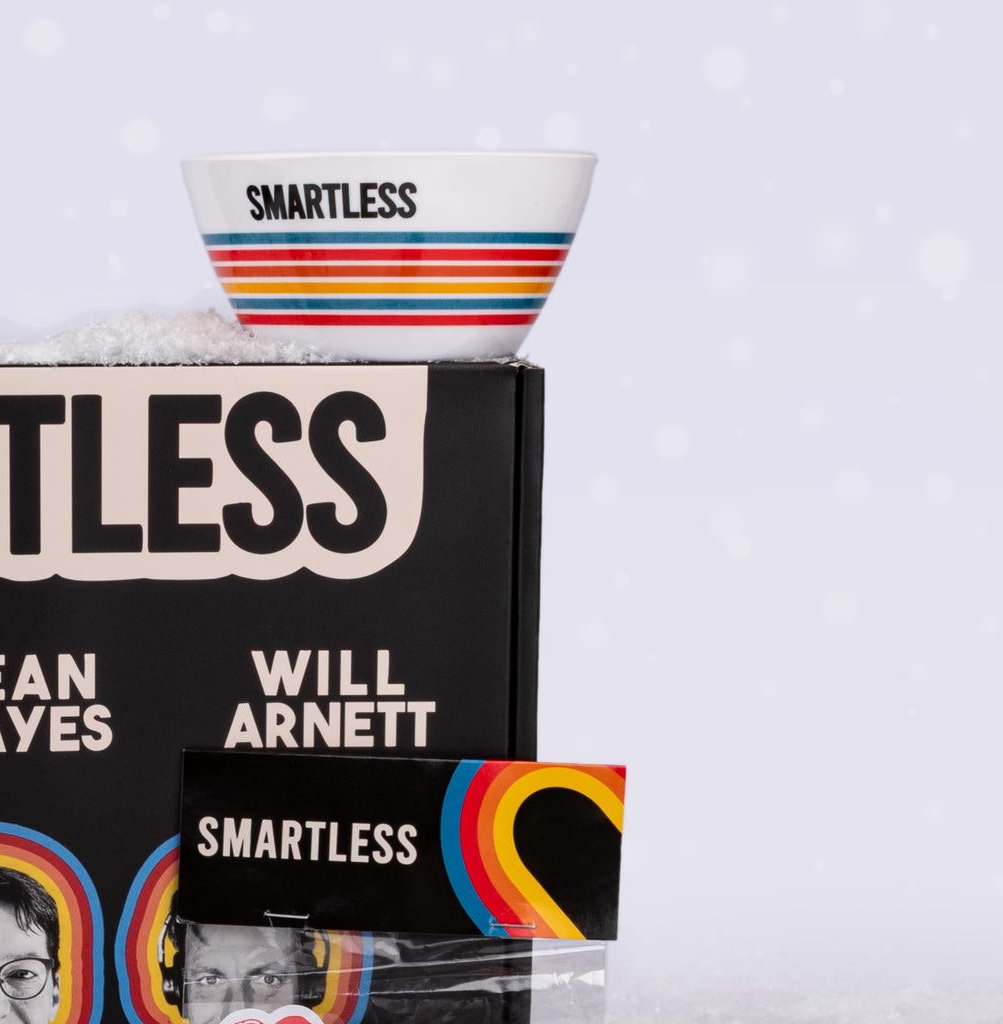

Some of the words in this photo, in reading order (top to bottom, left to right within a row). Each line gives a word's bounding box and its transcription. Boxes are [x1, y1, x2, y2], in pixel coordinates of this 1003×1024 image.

[246, 182, 417, 221] SMARTLESS
[251, 649, 405, 697] WILL
[224, 702, 436, 749] ARNETT
[197, 816, 418, 865] SMARTLESS
